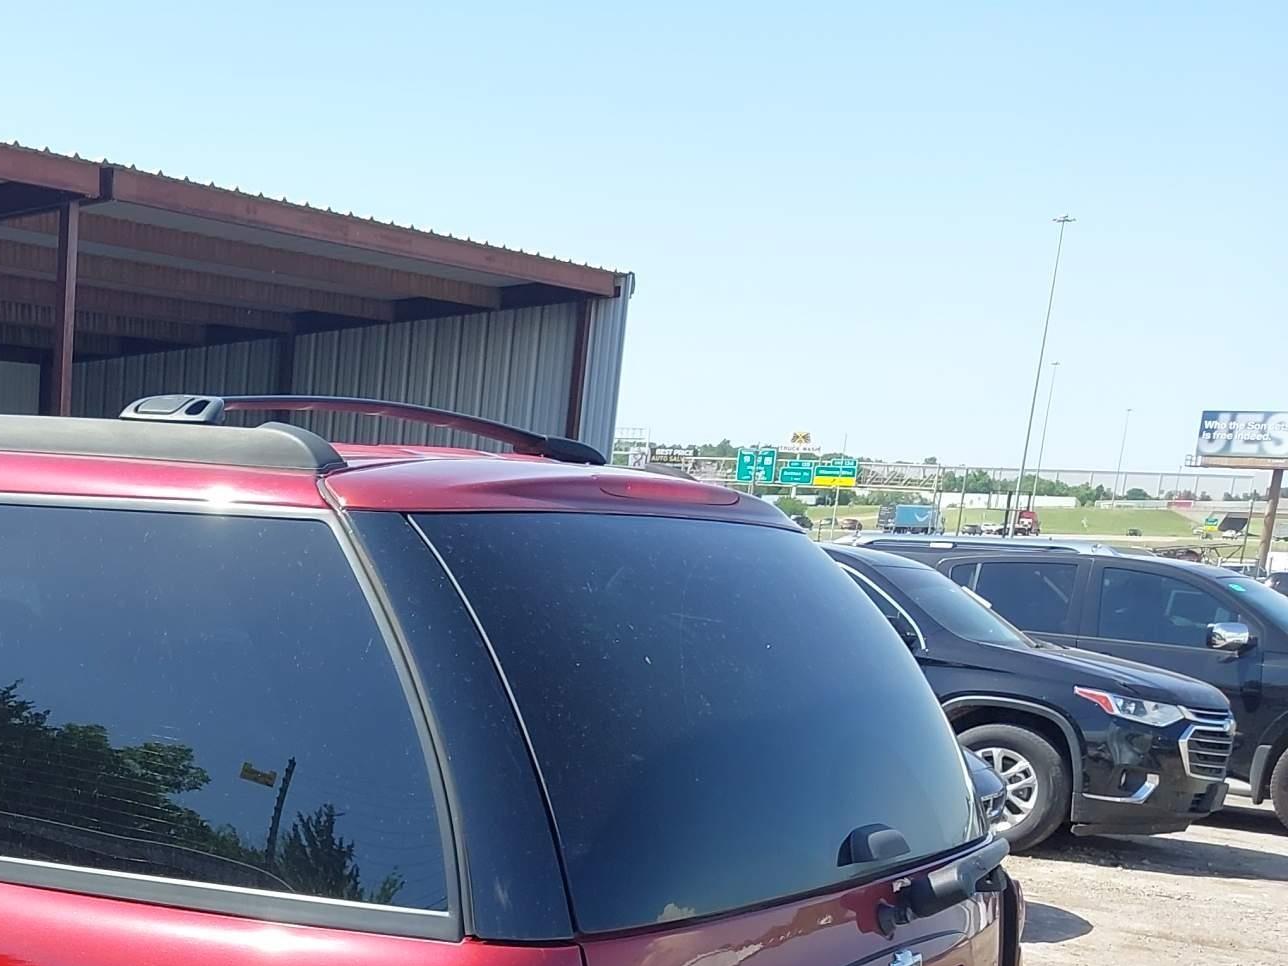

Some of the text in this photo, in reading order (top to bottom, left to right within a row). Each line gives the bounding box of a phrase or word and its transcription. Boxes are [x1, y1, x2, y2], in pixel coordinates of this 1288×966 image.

[1204, 420, 1227, 430] Who
[1247, 421, 1267, 431] Son
[655, 448, 674, 456] BEST
